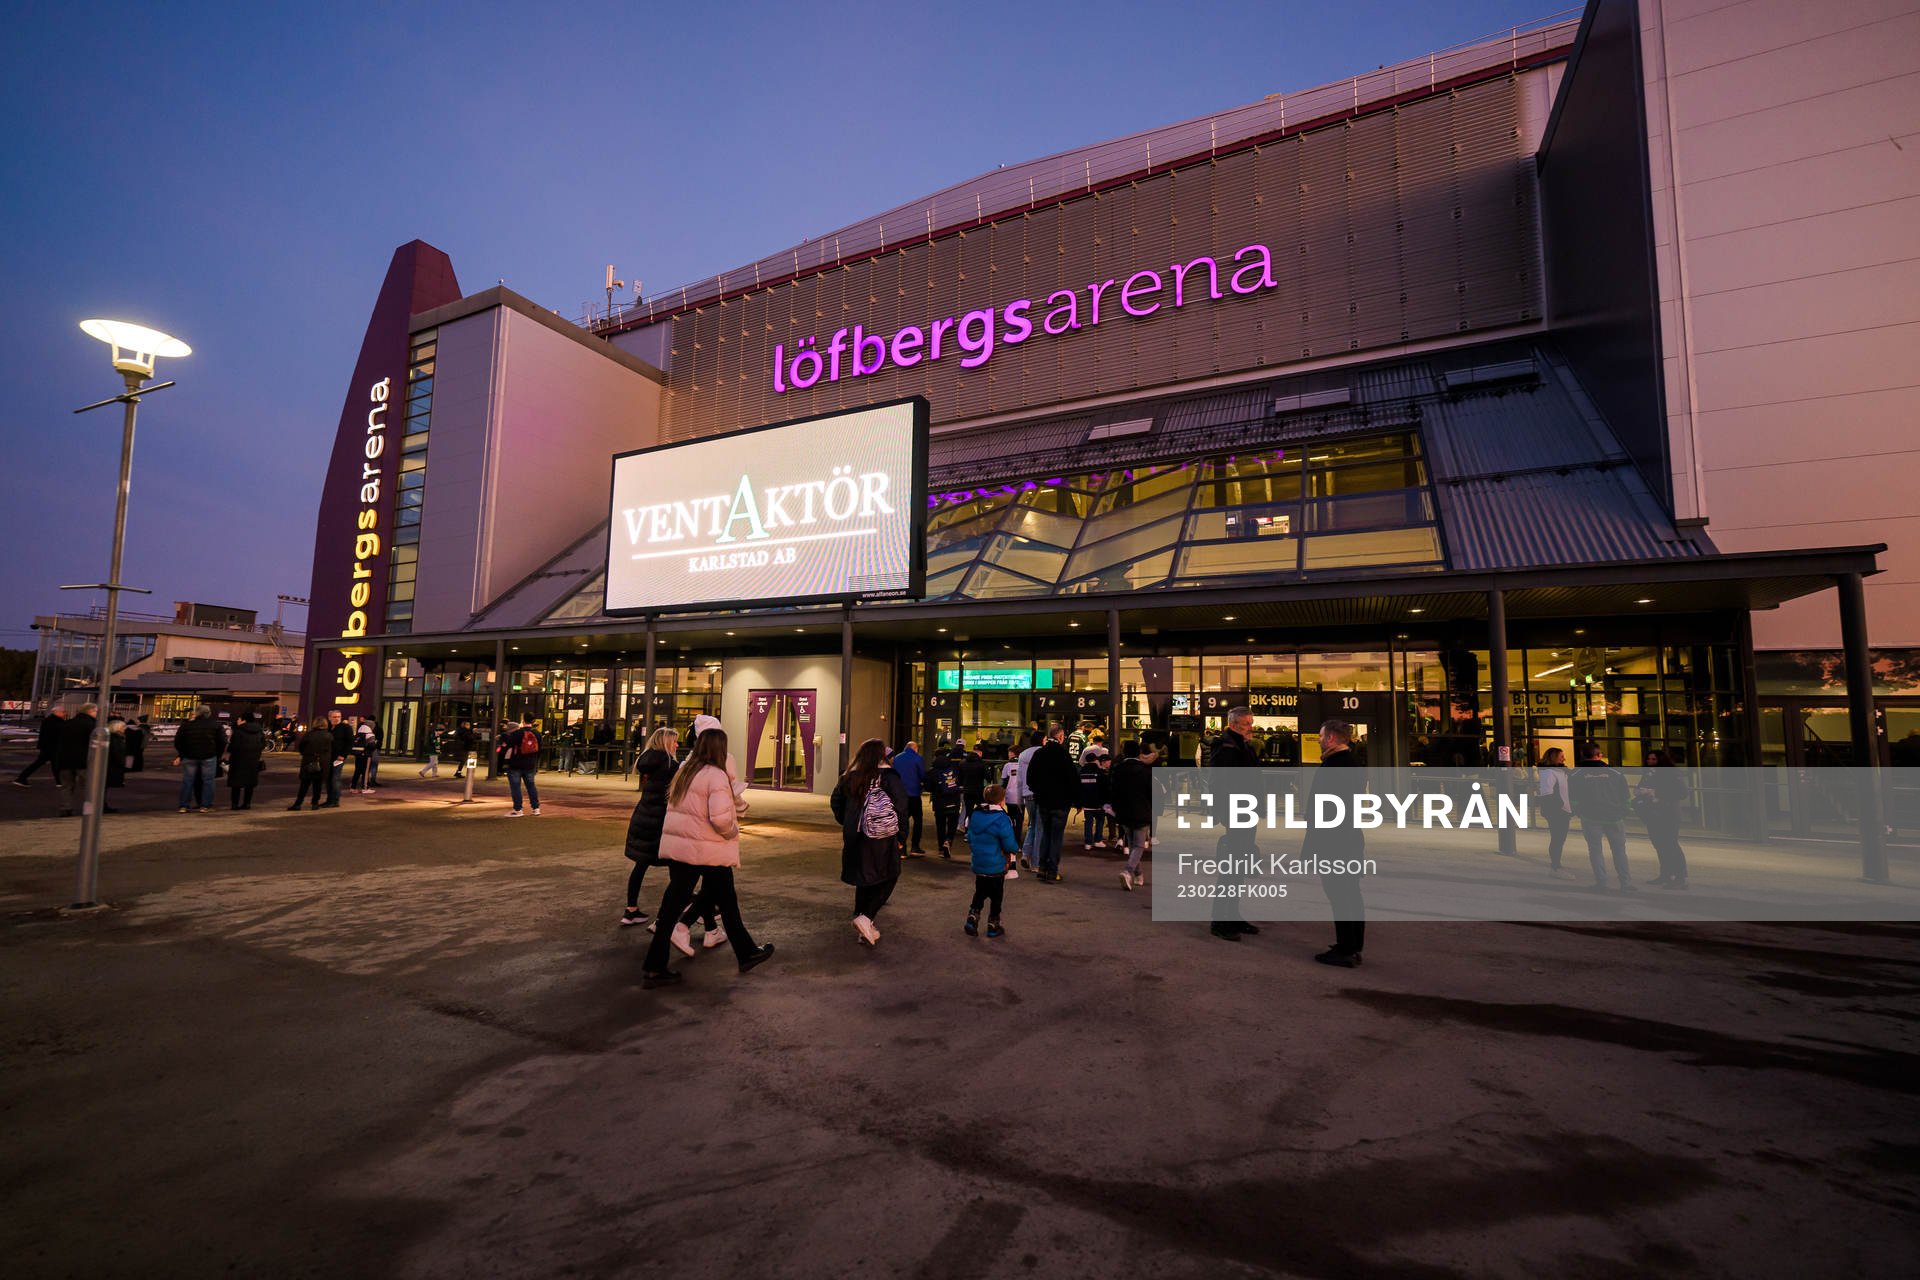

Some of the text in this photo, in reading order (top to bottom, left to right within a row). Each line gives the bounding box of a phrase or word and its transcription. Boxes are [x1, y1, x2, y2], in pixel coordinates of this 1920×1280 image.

[773, 243, 1278, 393] löfbergsarena
[622, 465, 895, 546] VENTAKTÖR
[335, 376, 391, 705] löbergsarena
[688, 548, 797, 573] KARLSTAD AB
[930, 696, 938, 707] 6
[1039, 697, 1046, 707] 7
[1077, 697, 1085, 708] 8
[1208, 697, 1217, 709] 9
[1342, 697, 1359, 709] 10
